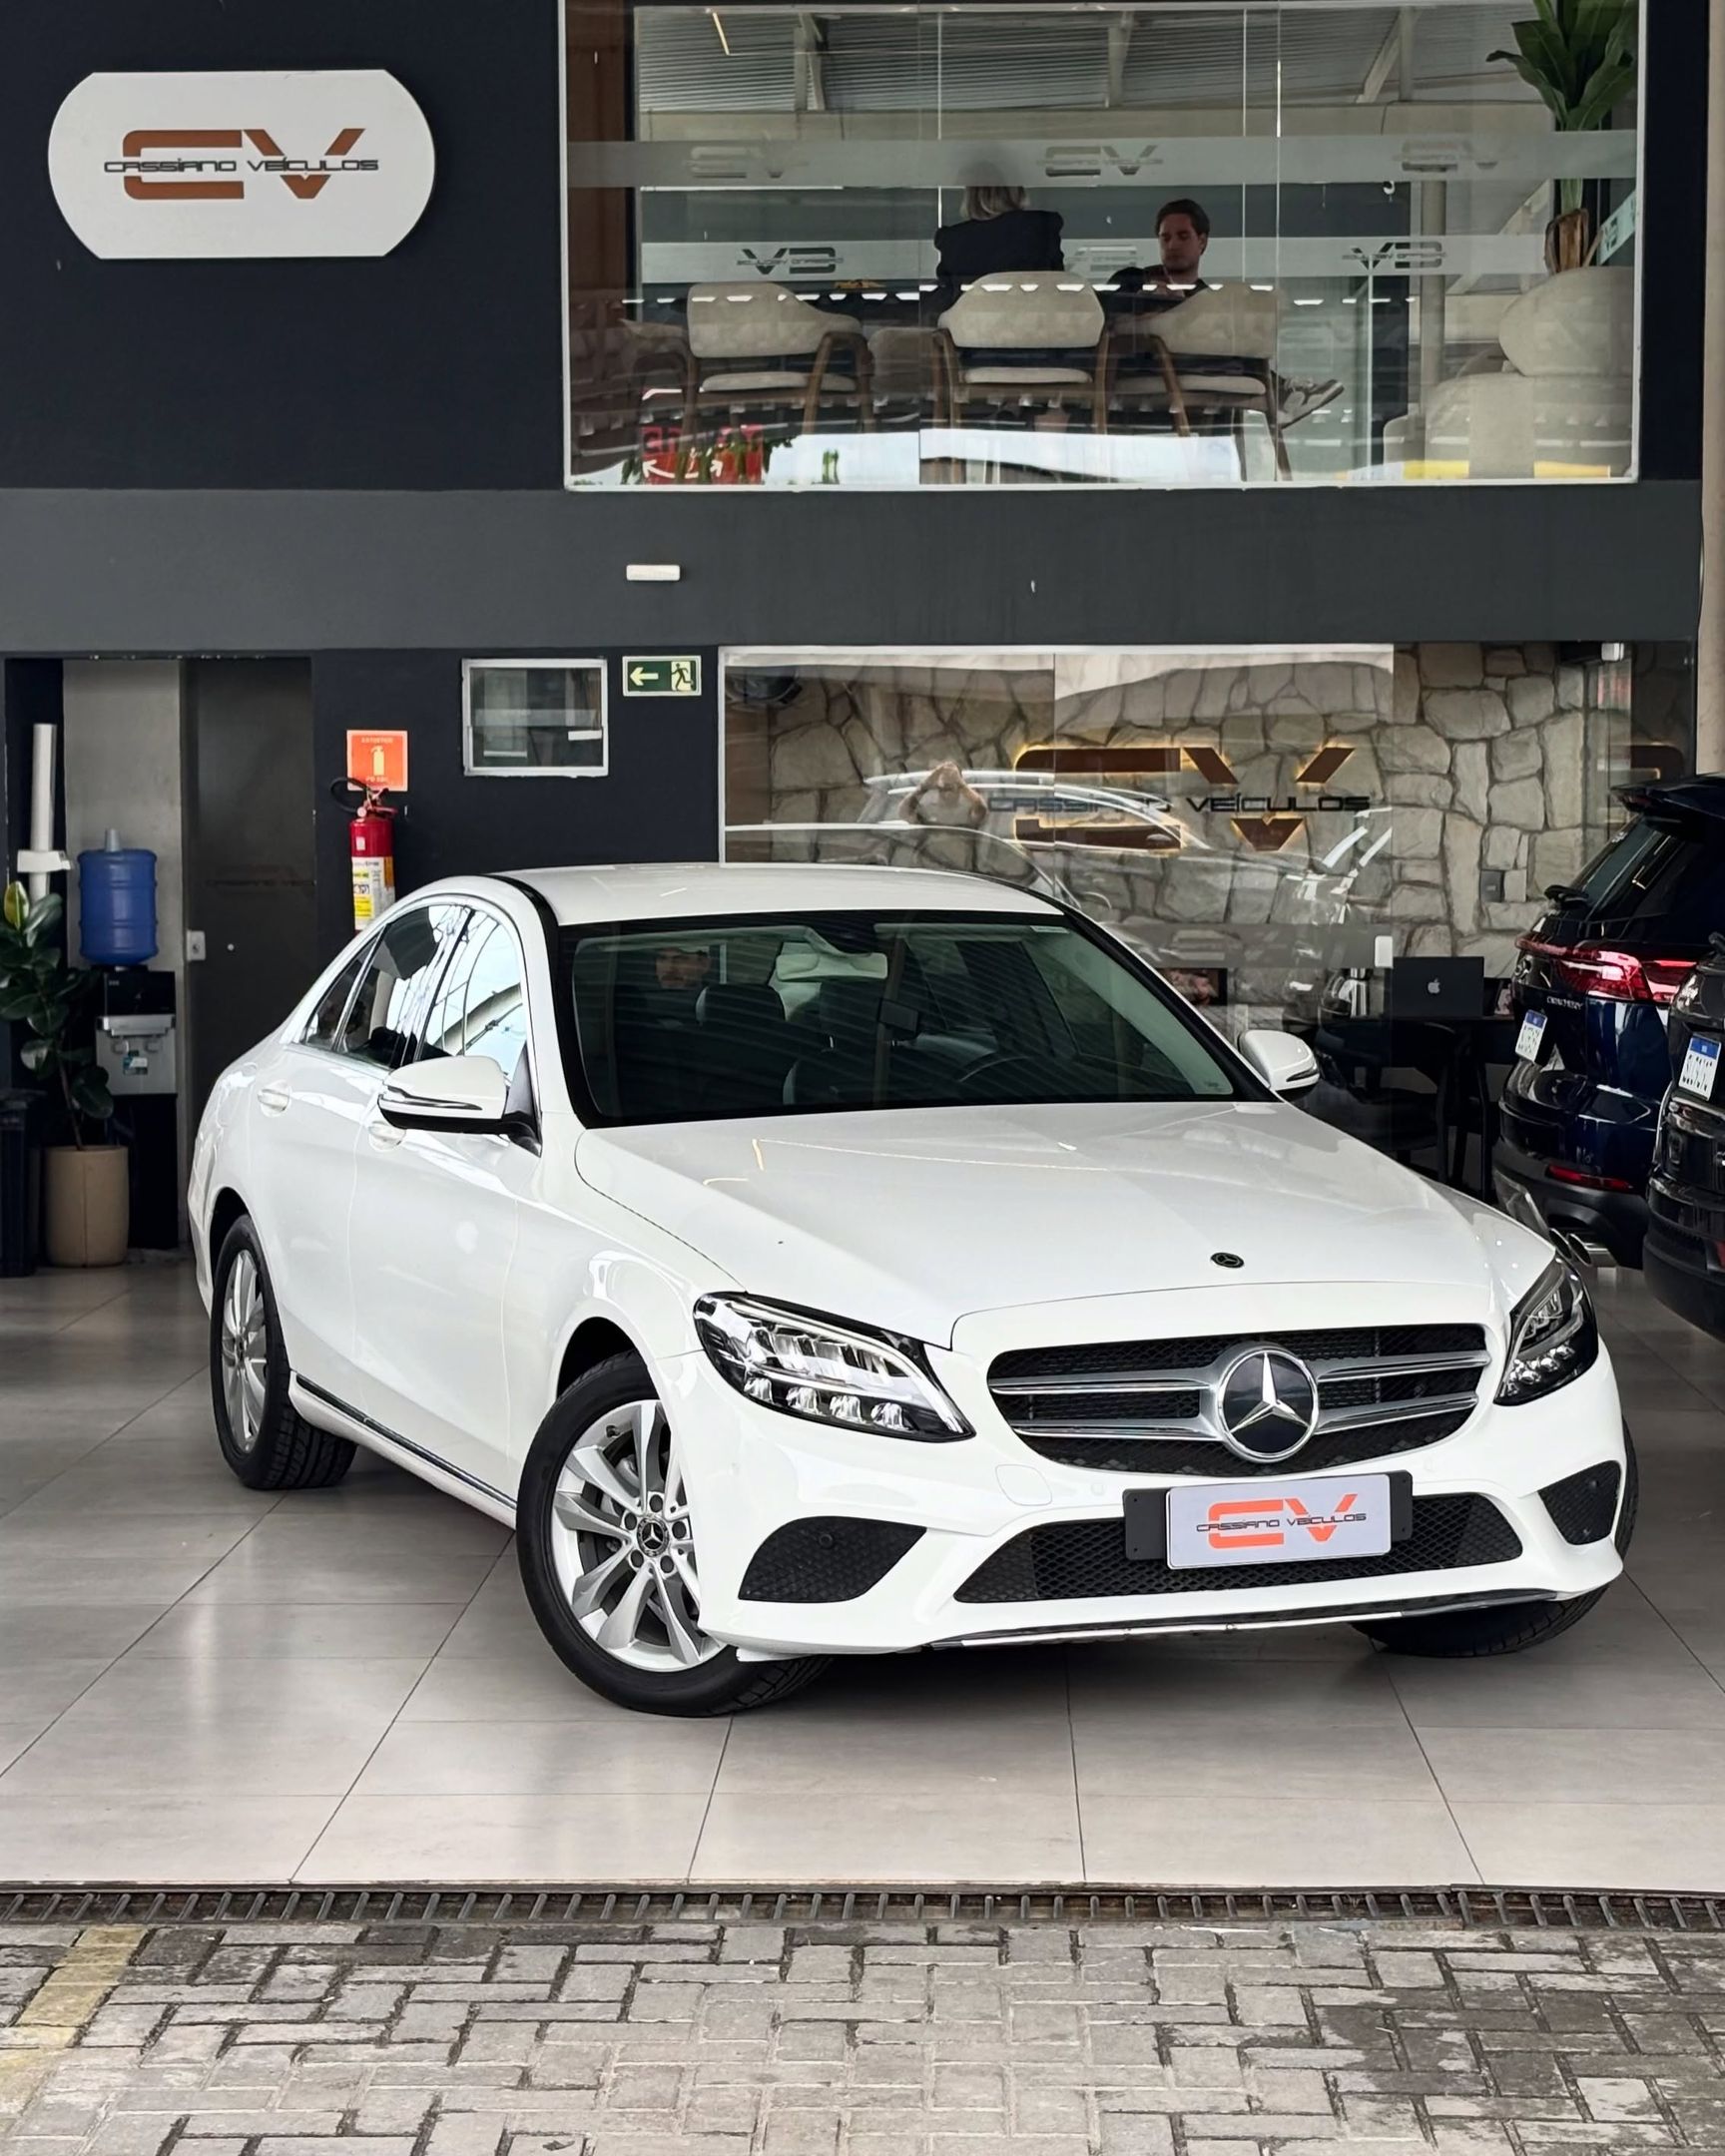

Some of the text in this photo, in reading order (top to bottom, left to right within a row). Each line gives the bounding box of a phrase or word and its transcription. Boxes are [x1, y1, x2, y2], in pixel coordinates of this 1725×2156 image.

[104, 157, 379, 173] CASSIANO VEÍCULOS
[1187, 793, 1371, 812] VEÍCULOS
[1196, 1519, 1281, 1533] CASSIANO
